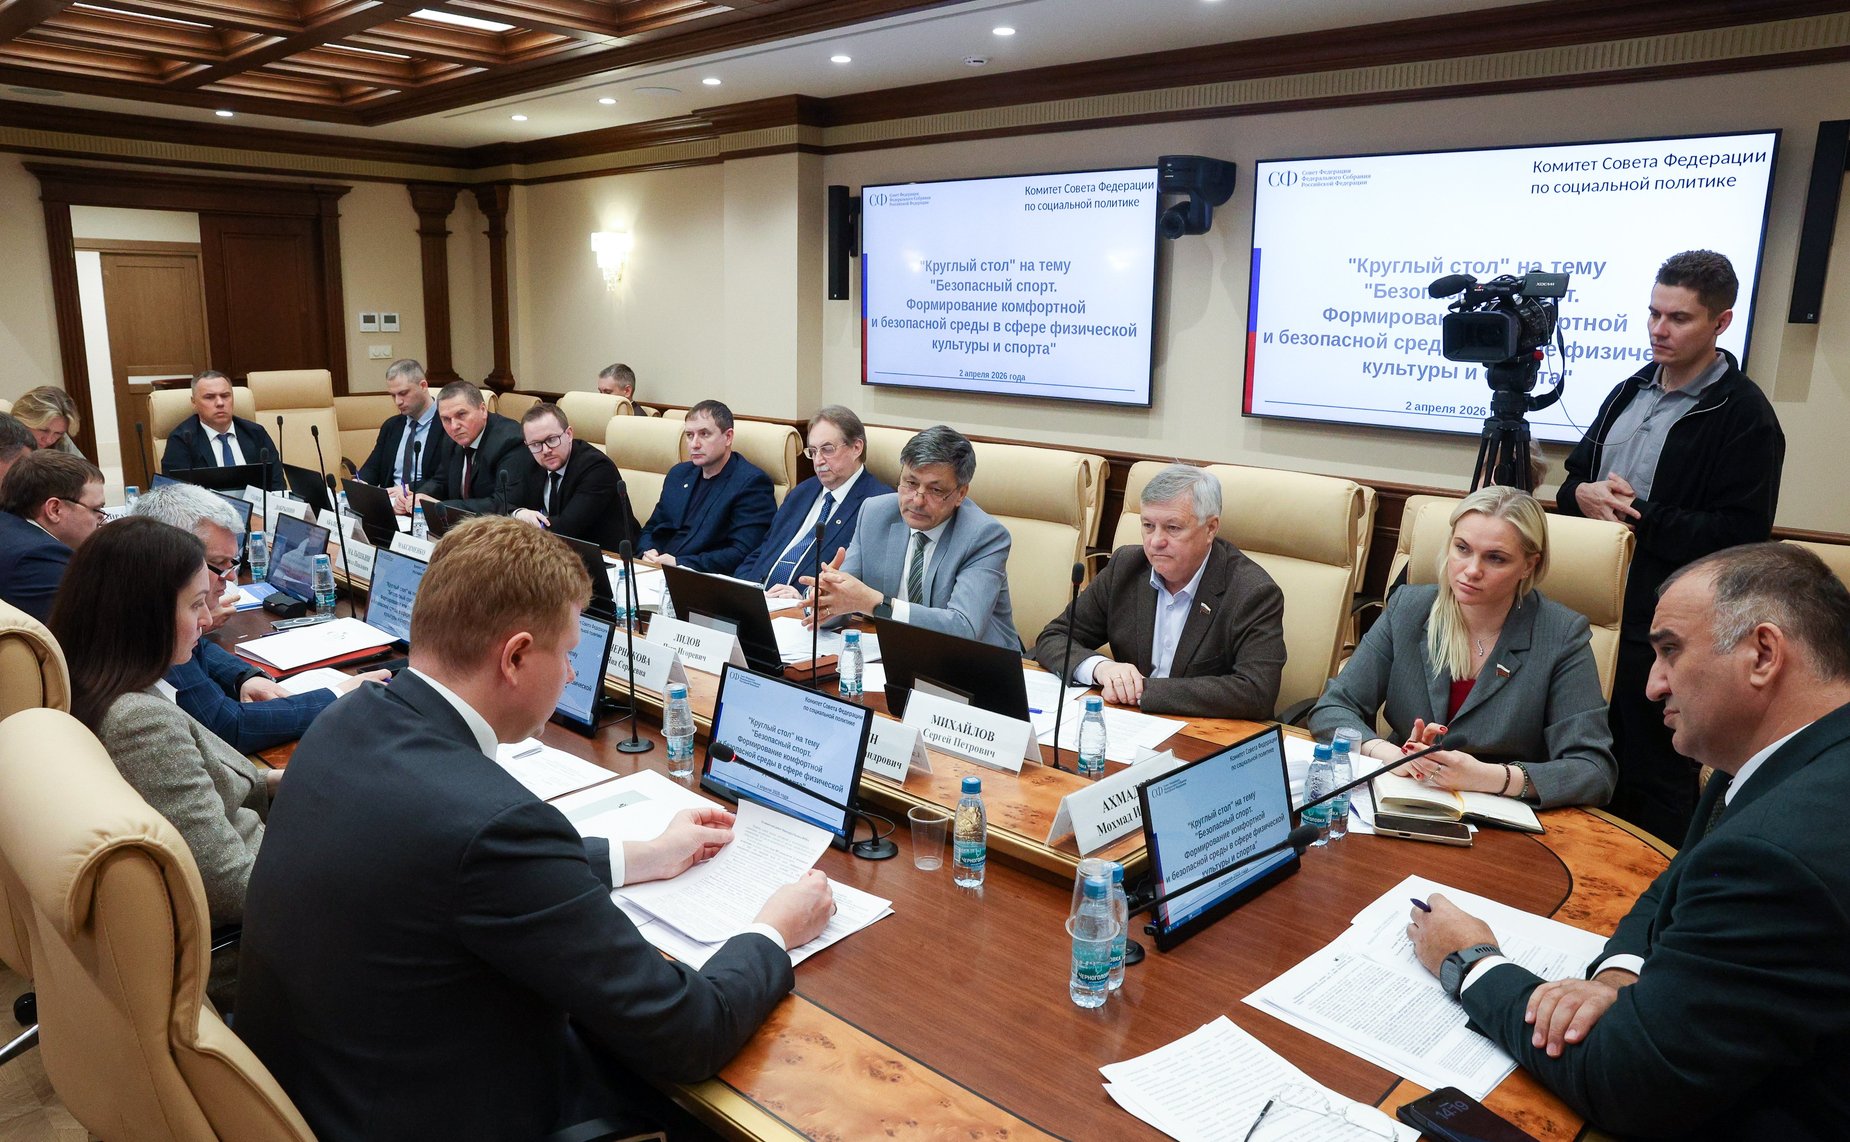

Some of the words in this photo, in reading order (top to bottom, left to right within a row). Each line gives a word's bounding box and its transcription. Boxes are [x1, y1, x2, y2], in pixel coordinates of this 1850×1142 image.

[1533, 160, 1598, 173] Комитет
[1602, 157, 1658, 170] Совета
[1664, 151, 1767, 169] Федерации
[1025, 185, 1062, 196] Комитет
[1064, 182, 1096, 194] Совета
[1098, 180, 1155, 193] Федерации
[1268, 170, 1298, 187] СФ
[1531, 183, 1549, 194] по
[1553, 177, 1650, 195] социальной
[1654, 176, 1737, 190] политике
[1024, 202, 1035, 212] по
[1037, 198, 1092, 211] социальной
[1094, 197, 1140, 208] политике
[920, 259, 977, 274] "Круглый
[980, 259, 1016, 273] стол"
[1019, 261, 1035, 272] на
[1038, 261, 1071, 275] тему
[1348, 257, 1443, 278] "Круглый
[1450, 258, 1510, 274] стол"
[1517, 260, 1543, 274] на
[1551, 260, 1607, 279] тему
[930, 278, 1013, 293] "Безопасный
[1016, 280, 1058, 296] спорт.
[906, 298, 998, 314] Формирование
[1001, 299, 1086, 316] комфортной
[871, 319, 878, 328] и
[881, 316, 947, 331] безопасной
[950, 319, 989, 334] среды
[993, 322, 1001, 332] в
[1004, 320, 1046, 336] сфере
[1049, 321, 1137, 338] физической
[1322, 307, 1444, 329] Формирова
[1558, 313, 1628, 334] ртной
[931, 338, 989, 354] культуры
[993, 341, 1001, 352] и
[1004, 341, 1056, 356] спорта"
[1263, 332, 1273, 344] и
[1279, 329, 1388, 350] безопасной
[1393, 336, 1443, 356] сред
[1563, 341, 1654, 363] физиче
[959, 369, 964, 377] 2
[964, 371, 990, 379] апреля
[991, 371, 1008, 380] 2026
[1009, 373, 1026, 382] года
[1362, 361, 1458, 382] культуры
[1465, 367, 1477, 380] и
[1405, 401, 1412, 411] 2
[1414, 403, 1456, 415] апреля
[1459, 405, 1486, 416] 2026
[673, 633, 701, 648] ЛИДОВ
[610, 643, 651, 666] ЧЕРНКОВА
[677, 646, 707, 662] Игоревич
[805, 697, 823, 707] Комитет
[823, 702, 838, 712] Совета
[838, 707, 864, 720] Федерации
[809, 707, 834, 719] социальной
[748, 717, 776, 734] "Круглый
[777, 729, 795, 739] стол"
[795, 735, 803, 743] на
[804, 738, 820, 750] тему
[931, 714, 996, 742] МИХАЙЛОВ
[738, 735, 782, 758] Формирование
[783, 752, 823, 773] комфортной
[751, 729, 792, 751] "Безопасный
[792, 745, 812, 758] спорт.
[922, 728, 952, 744] Сергей
[953, 737, 996, 758] Петрович
[865, 751, 902, 770] ндрович
[757, 755, 776, 768] среды
[783, 763, 803, 778] сфере
[804, 770, 844, 793] физической
[1103, 779, 1150, 813] АХМАД
[1188, 809, 1217, 830] "Круглый
[1218, 801, 1234, 816] стол"
[1234, 798, 1242, 807] на
[1243, 791, 1256, 804] тему
[1096, 812, 1133, 837] Мохмад
[1195, 814, 1235, 840] "Безопасный
[1235, 807, 1253, 824] спорт.
[1184, 830, 1230, 859] Формирование
[1231, 811, 1266, 839] комфортной
[1171, 856, 1208, 881] безопасной
[1209, 846, 1229, 861] среды
[1234, 833, 1252, 847] сфере
[1253, 814, 1285, 838] физической
[1236, 841, 1258, 860] спорта"
